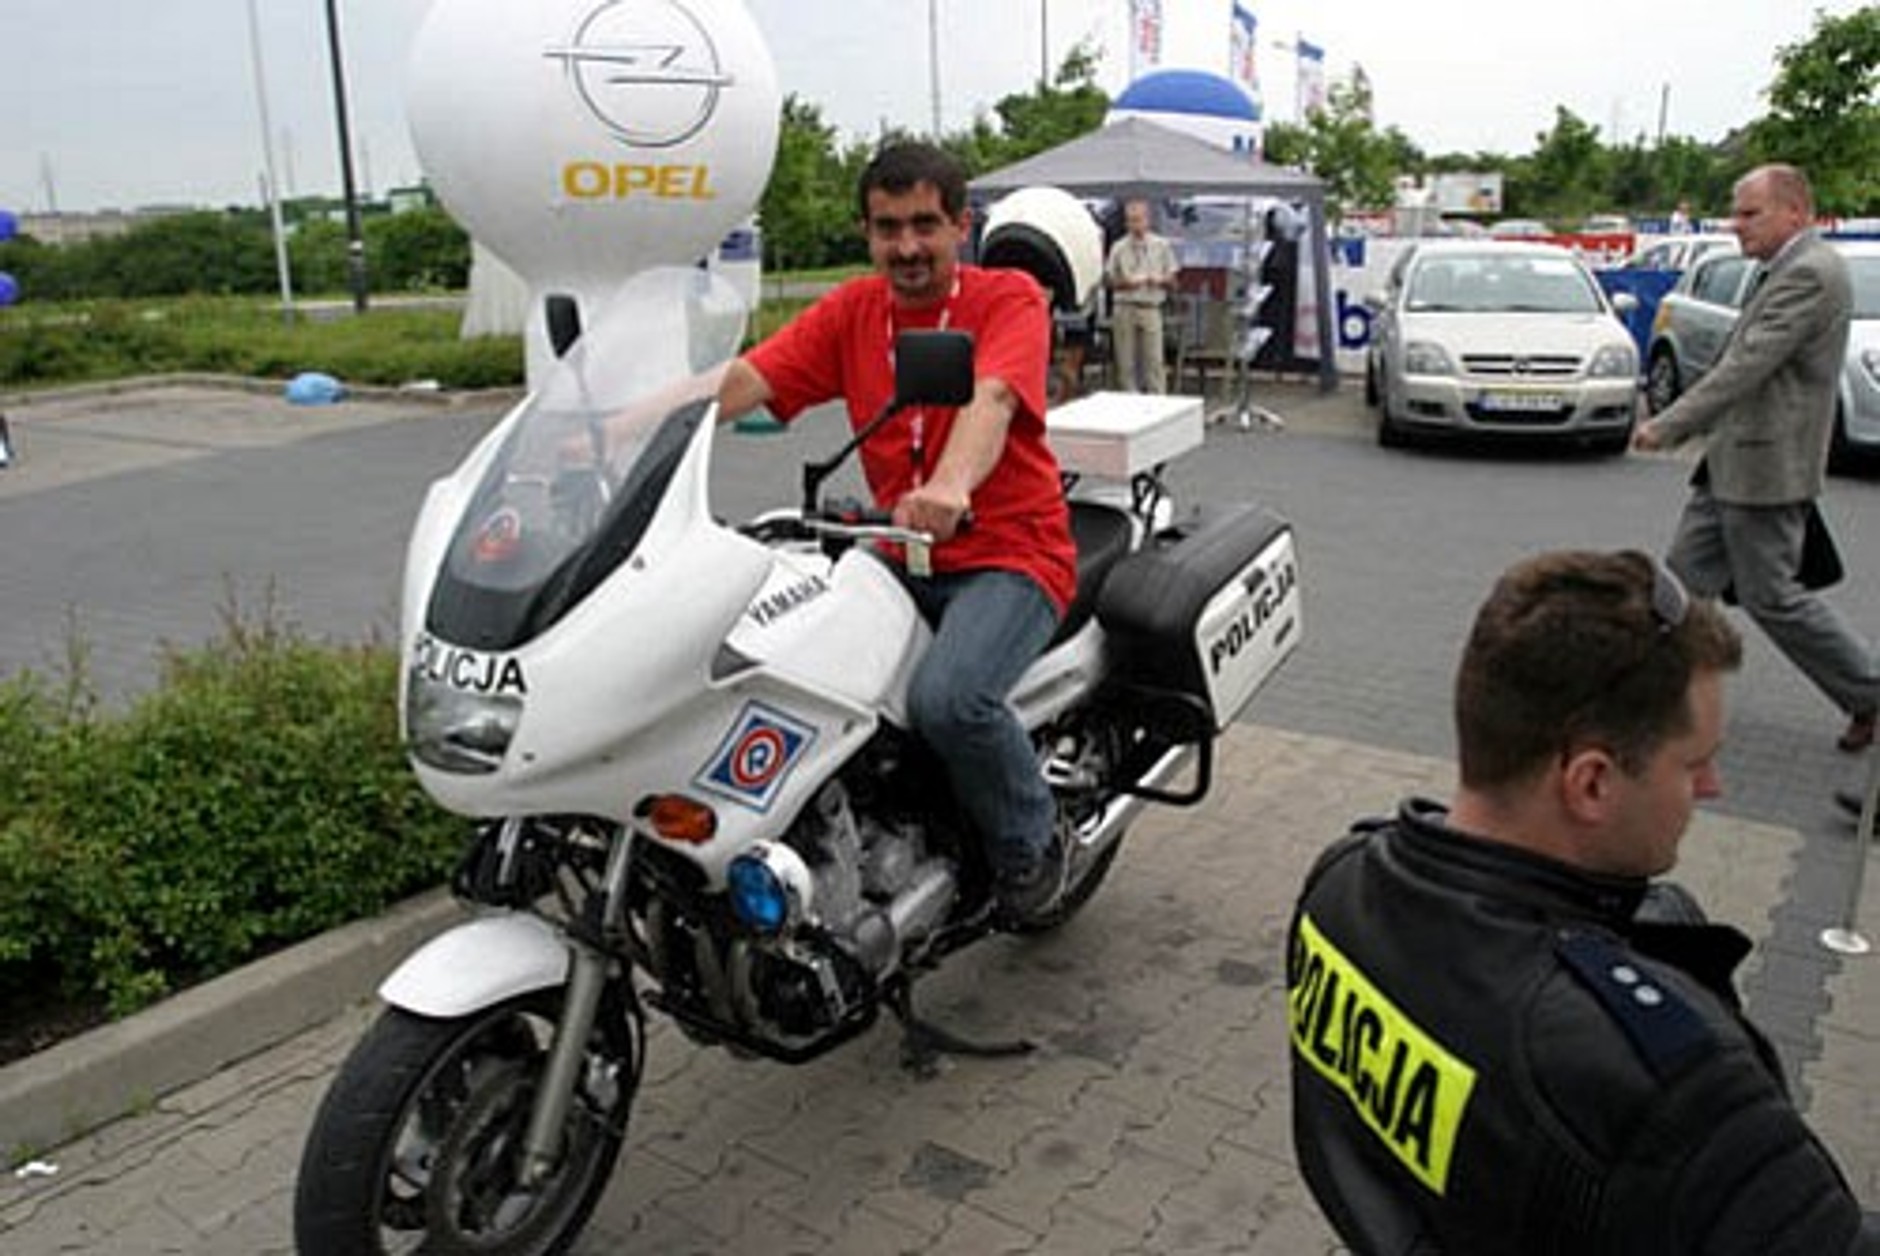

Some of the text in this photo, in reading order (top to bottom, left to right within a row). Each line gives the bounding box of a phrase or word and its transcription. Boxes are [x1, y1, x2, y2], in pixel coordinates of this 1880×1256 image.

[564, 160, 719, 200] OPEL
[749, 574, 830, 627] YAMAHA
[1210, 564, 1295, 674] POLICJA
[413, 634, 527, 693] OLICJA
